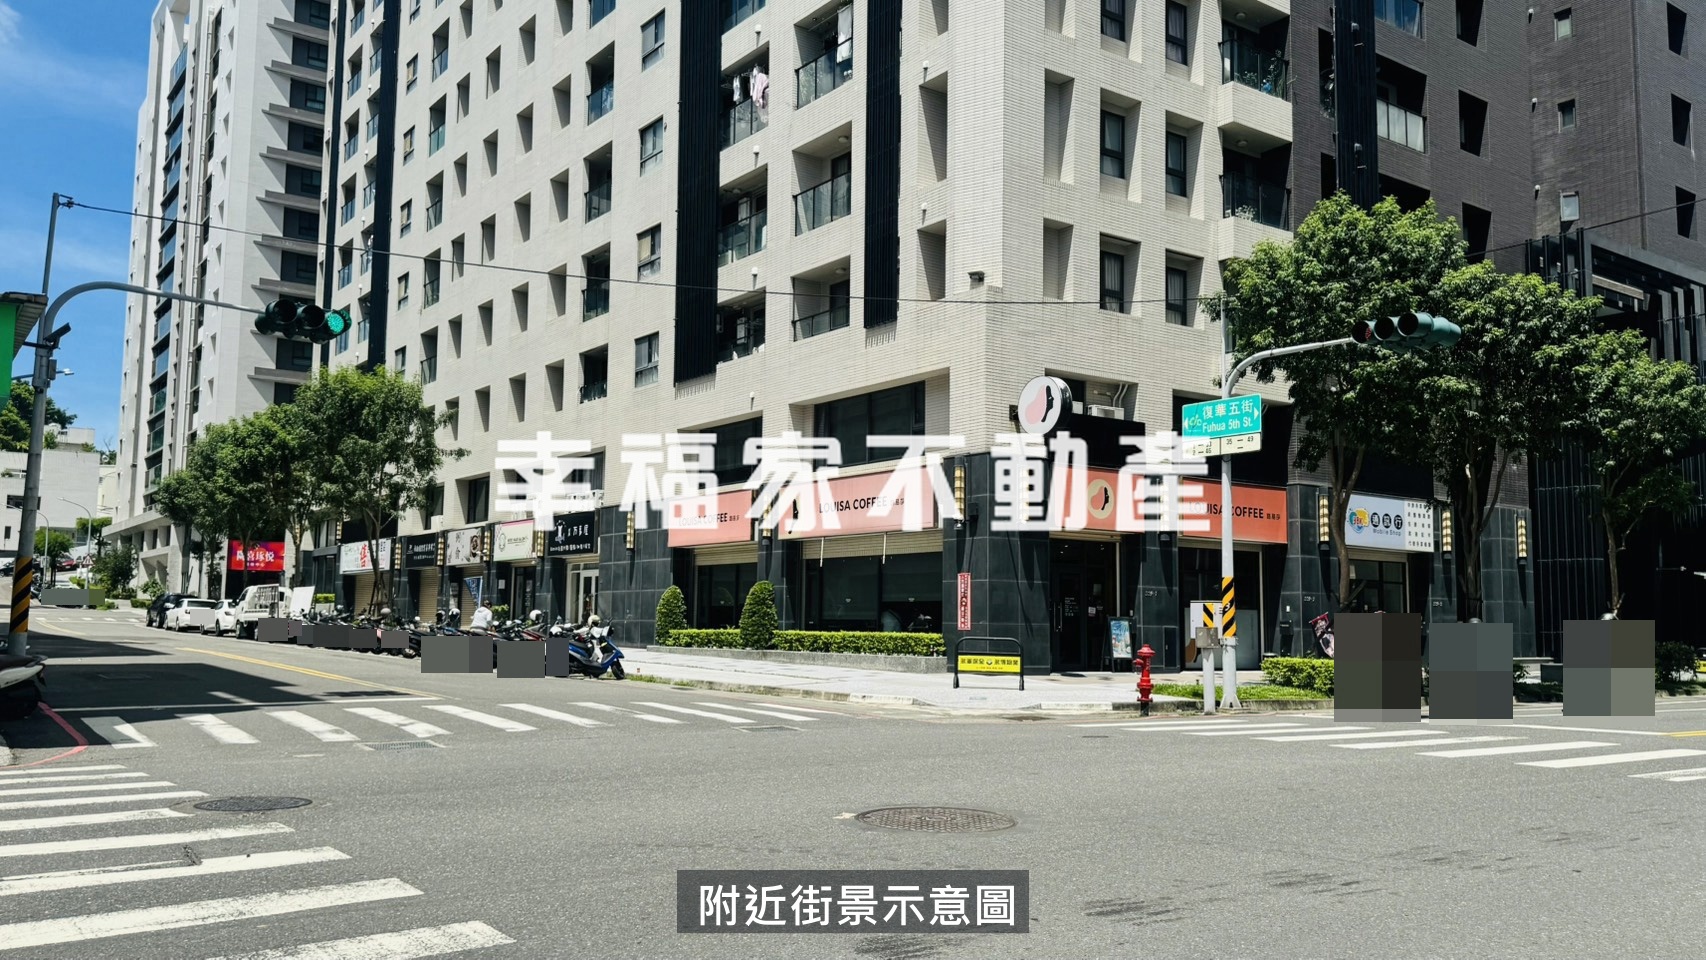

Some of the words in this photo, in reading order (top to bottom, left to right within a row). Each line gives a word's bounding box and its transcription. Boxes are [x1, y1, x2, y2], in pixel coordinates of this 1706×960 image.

[1202, 399, 1254, 419] 復華五街
[1202, 421, 1226, 433] Fuhua
[1228, 418, 1240, 430] 5th
[818, 500, 851, 514] LOUISA
[853, 496, 888, 510] COFFEE
[1231, 506, 1264, 519] OFFEE
[703, 512, 728, 525] COFFEE
